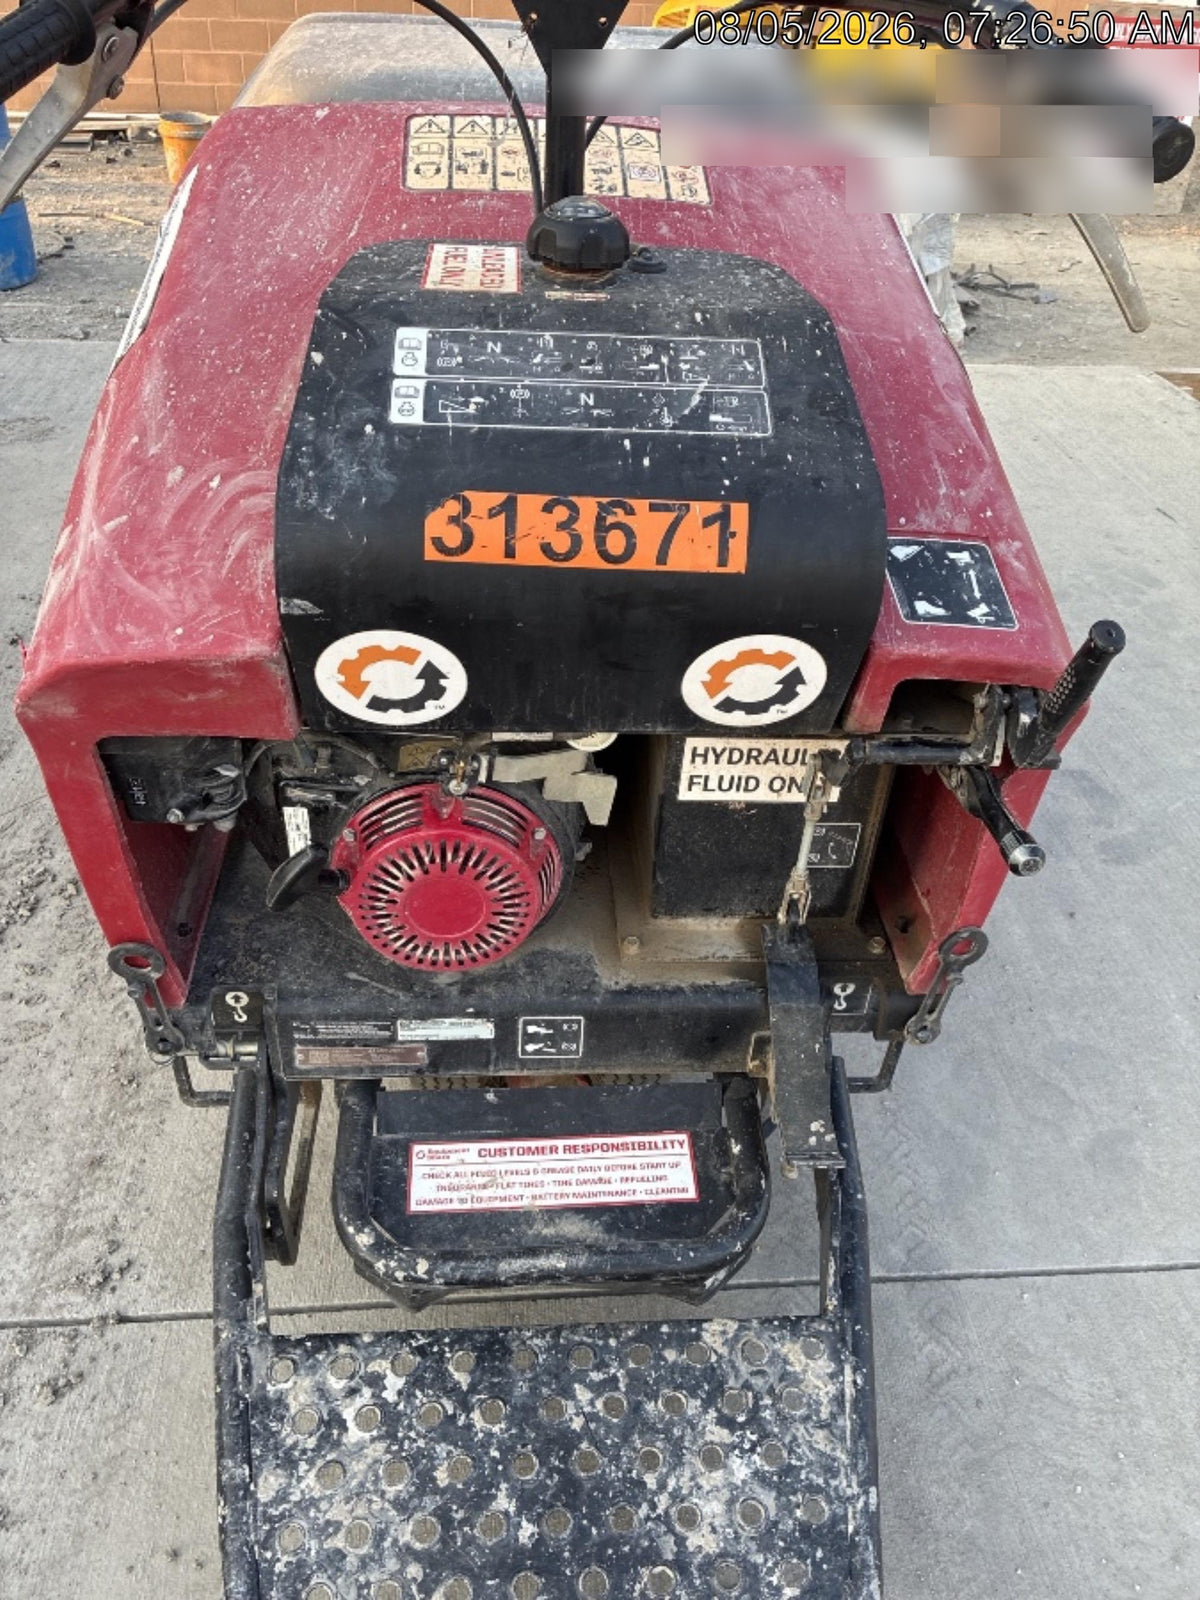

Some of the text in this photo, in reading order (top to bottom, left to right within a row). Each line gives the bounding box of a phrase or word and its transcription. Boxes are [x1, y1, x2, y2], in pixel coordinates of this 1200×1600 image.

[430, 493, 732, 567] 313671
[690, 746, 808, 766] HYDRAUL
[687, 774, 804, 794] FLUID ON
[478, 1139, 686, 1158] CUSTOMER RESPONSIBILITY
[640, 1161, 666, 1170] START
